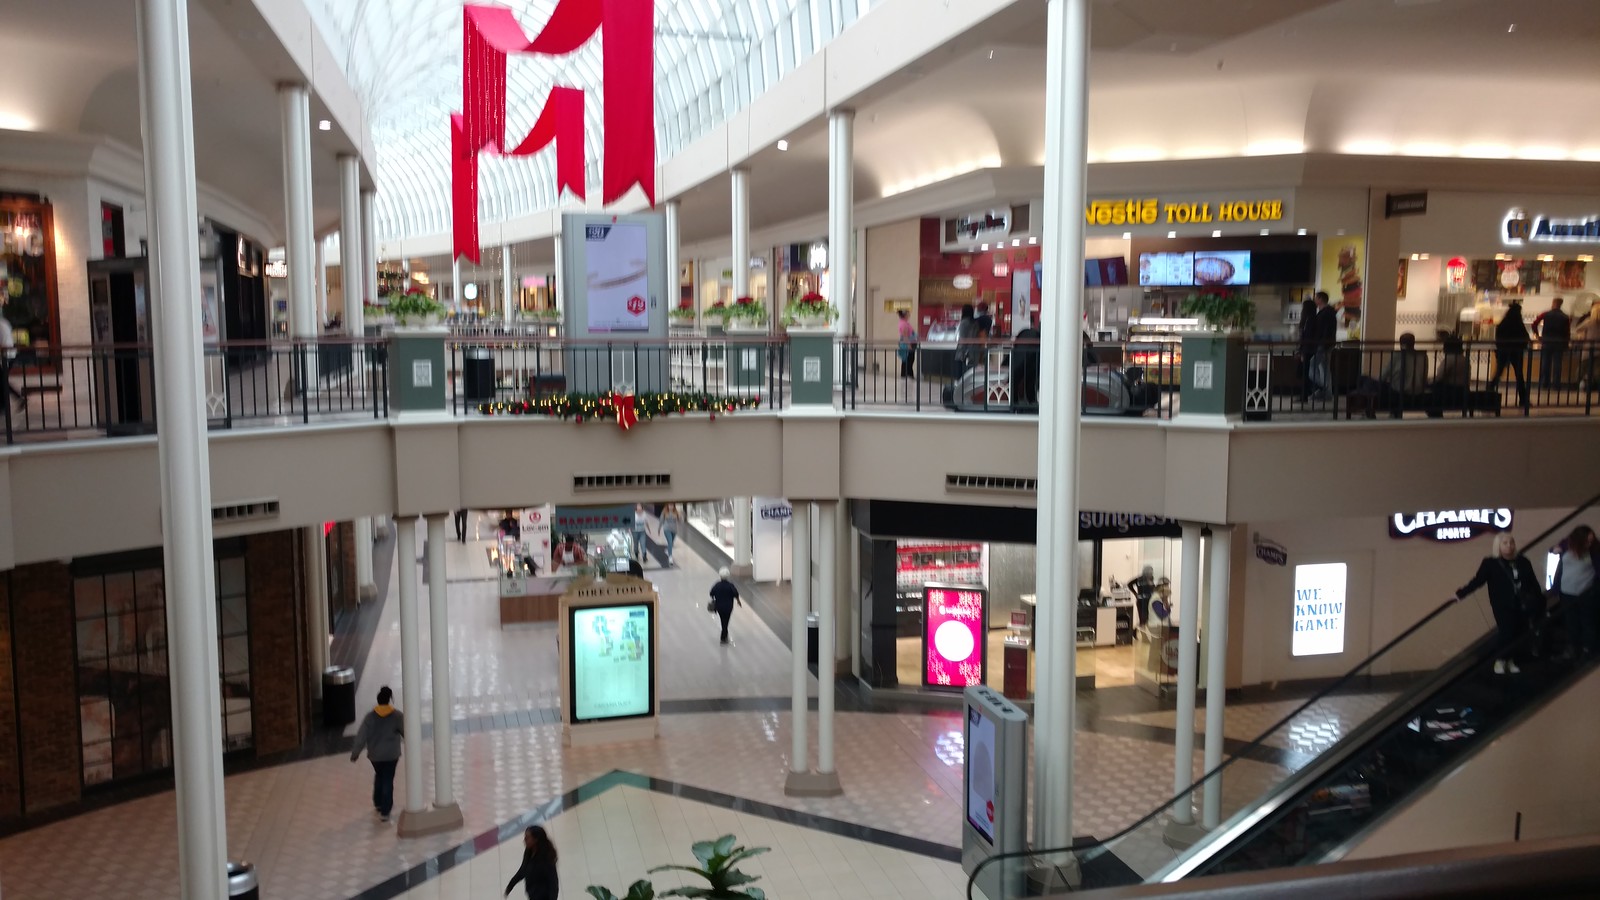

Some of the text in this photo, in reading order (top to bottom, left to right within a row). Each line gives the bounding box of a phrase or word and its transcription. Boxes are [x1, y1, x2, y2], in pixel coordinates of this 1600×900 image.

[1164, 202, 1213, 224] TOLL
[1218, 199, 1283, 222] HOUSE
[1436, 527, 1471, 540] SPORTS
[578, 586, 643, 598] DIRECTORY
[1296, 588, 1322, 601] WE
[1296, 602, 1343, 617] KNOW
[1294, 617, 1339, 632] GAME
